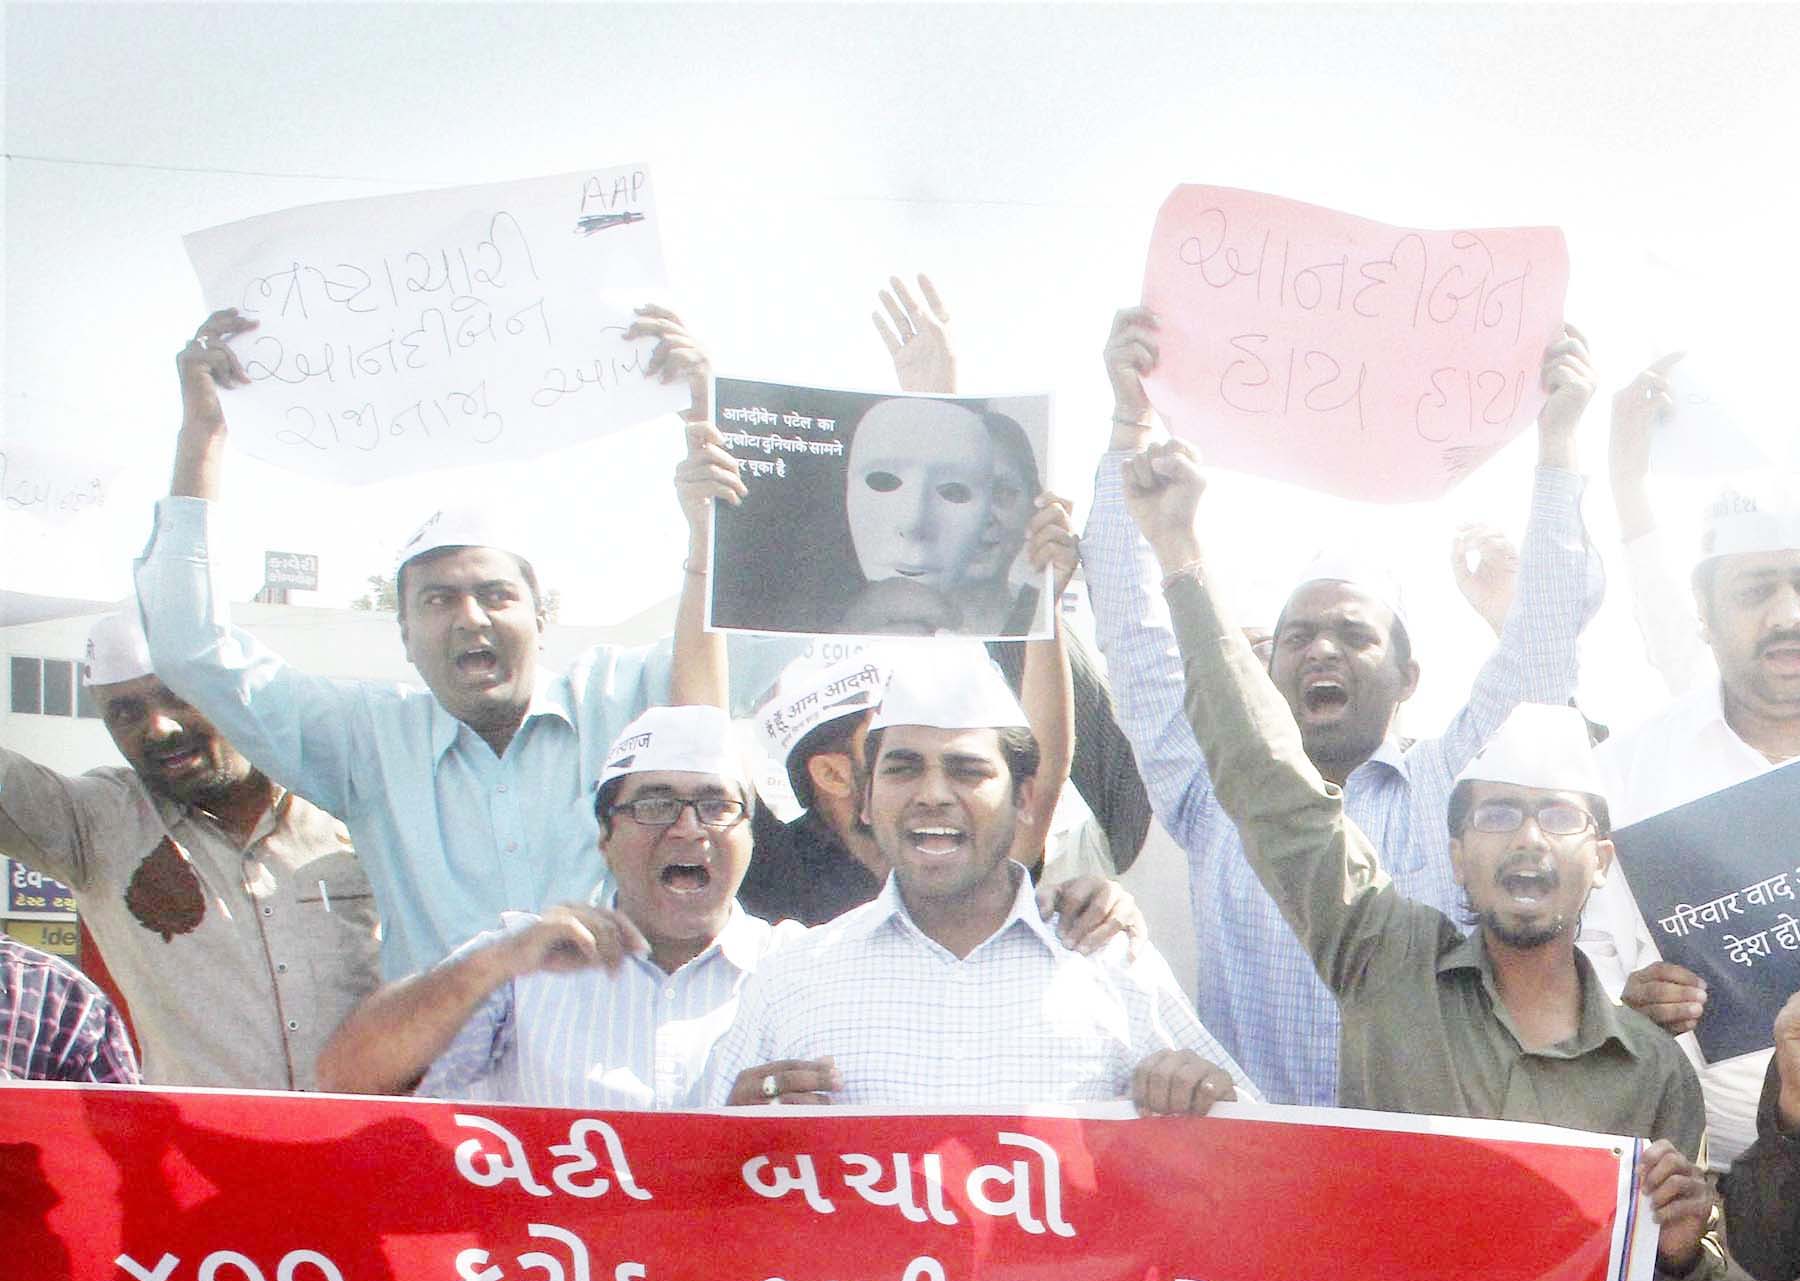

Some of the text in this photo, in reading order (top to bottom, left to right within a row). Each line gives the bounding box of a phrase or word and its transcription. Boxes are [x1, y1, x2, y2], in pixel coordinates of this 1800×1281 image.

[581, 170, 647, 211] AAP
[782, 411, 812, 430] पटेल
[787, 690, 819, 718] आम
[824, 663, 881, 697] आदमी
[1659, 891, 1745, 937] परिवार
[1742, 873, 1795, 905] वाद
[1724, 931, 1772, 968] देश
[453, 1113, 1076, 1239] બેટી બચાવો
